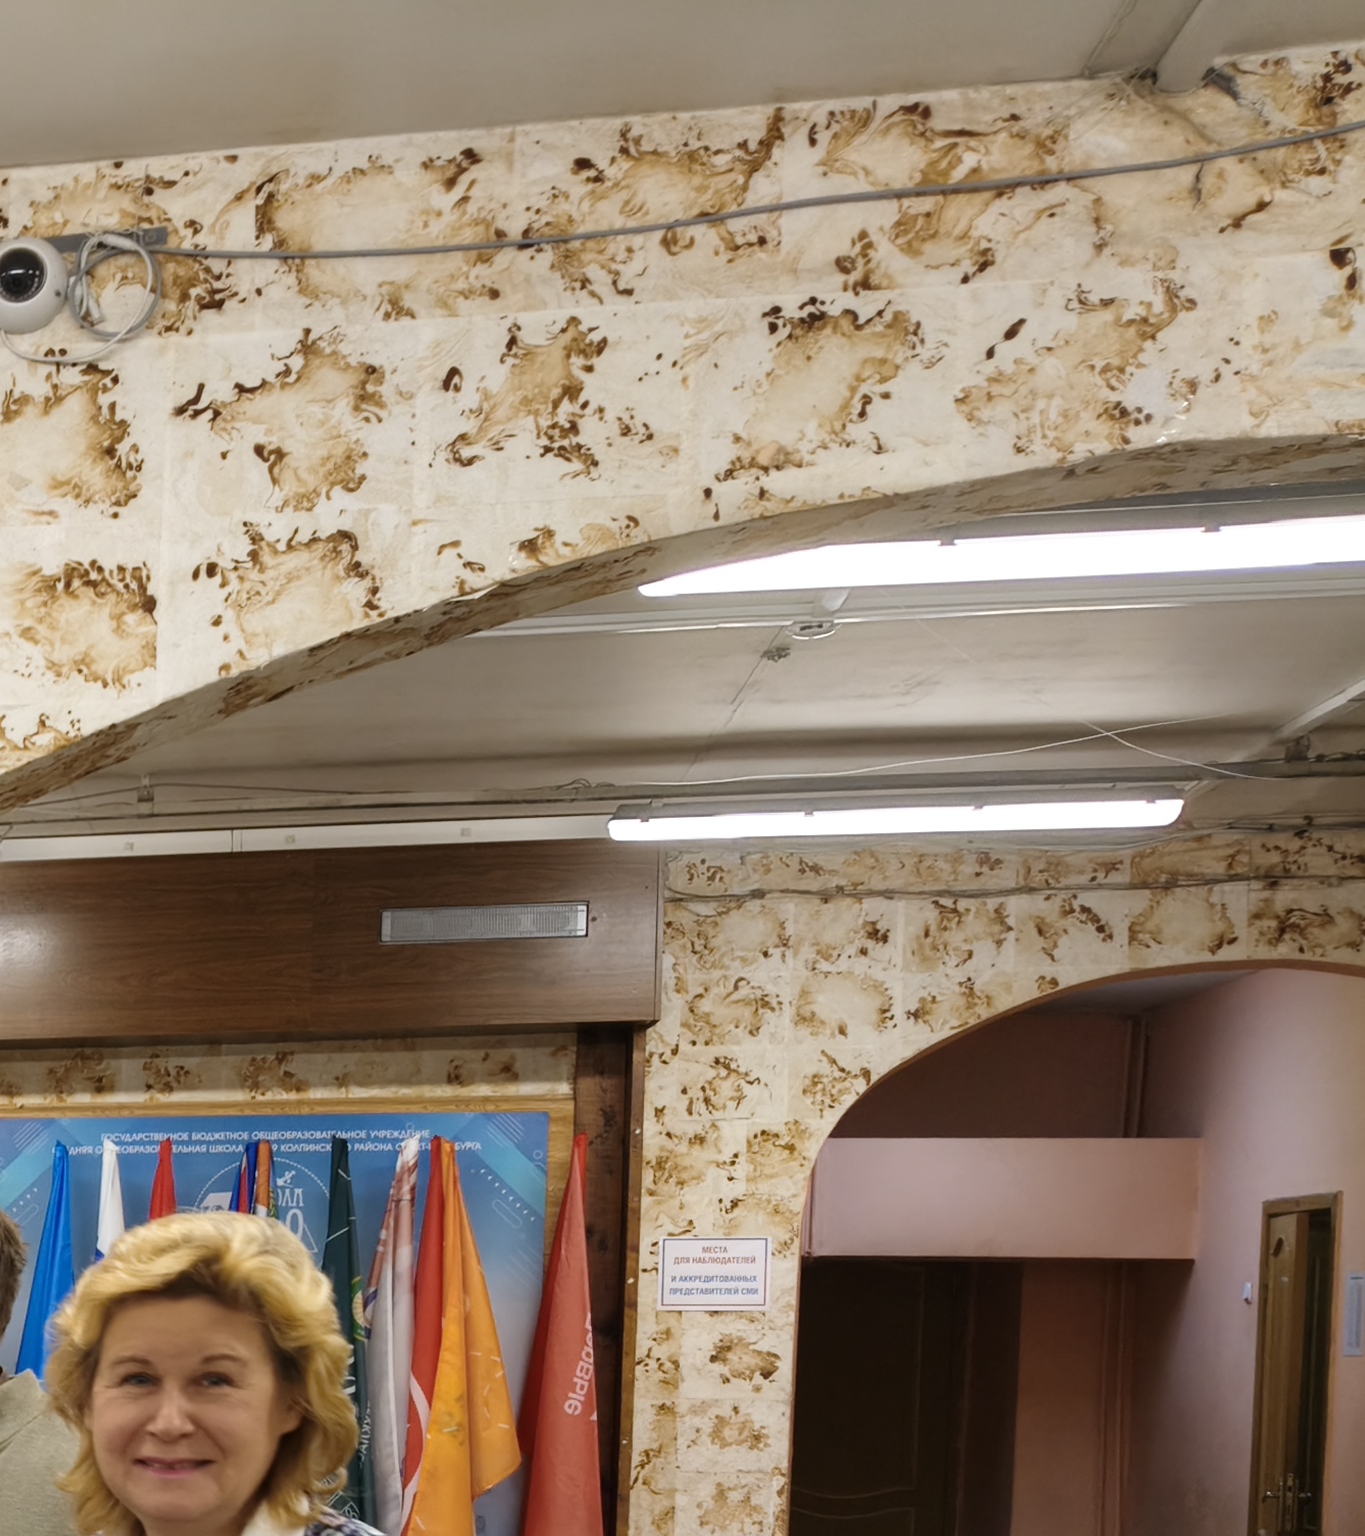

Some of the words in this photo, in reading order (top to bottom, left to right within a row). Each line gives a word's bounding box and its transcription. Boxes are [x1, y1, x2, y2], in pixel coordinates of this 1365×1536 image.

[192, 1131, 249, 1142] БЮДЖЕТНОЕ
[209, 1143, 244, 1153] ШКОЛА
[280, 1142, 351, 1152] КОЛПИНСК
[354, 1141, 393, 1151] РАЙОНА
[673, 1256, 690, 1265] ДЛЯ
[692, 1255, 756, 1265] НАБЛЮДАТЕЛЕЙ
[678, 1275, 757, 1283] АККРЕДИТОВАННЫХ
[669, 1286, 739, 1296] ПРЕДСТАВИТЕЛЕЙ
[741, 1287, 759, 1295] СМИ
